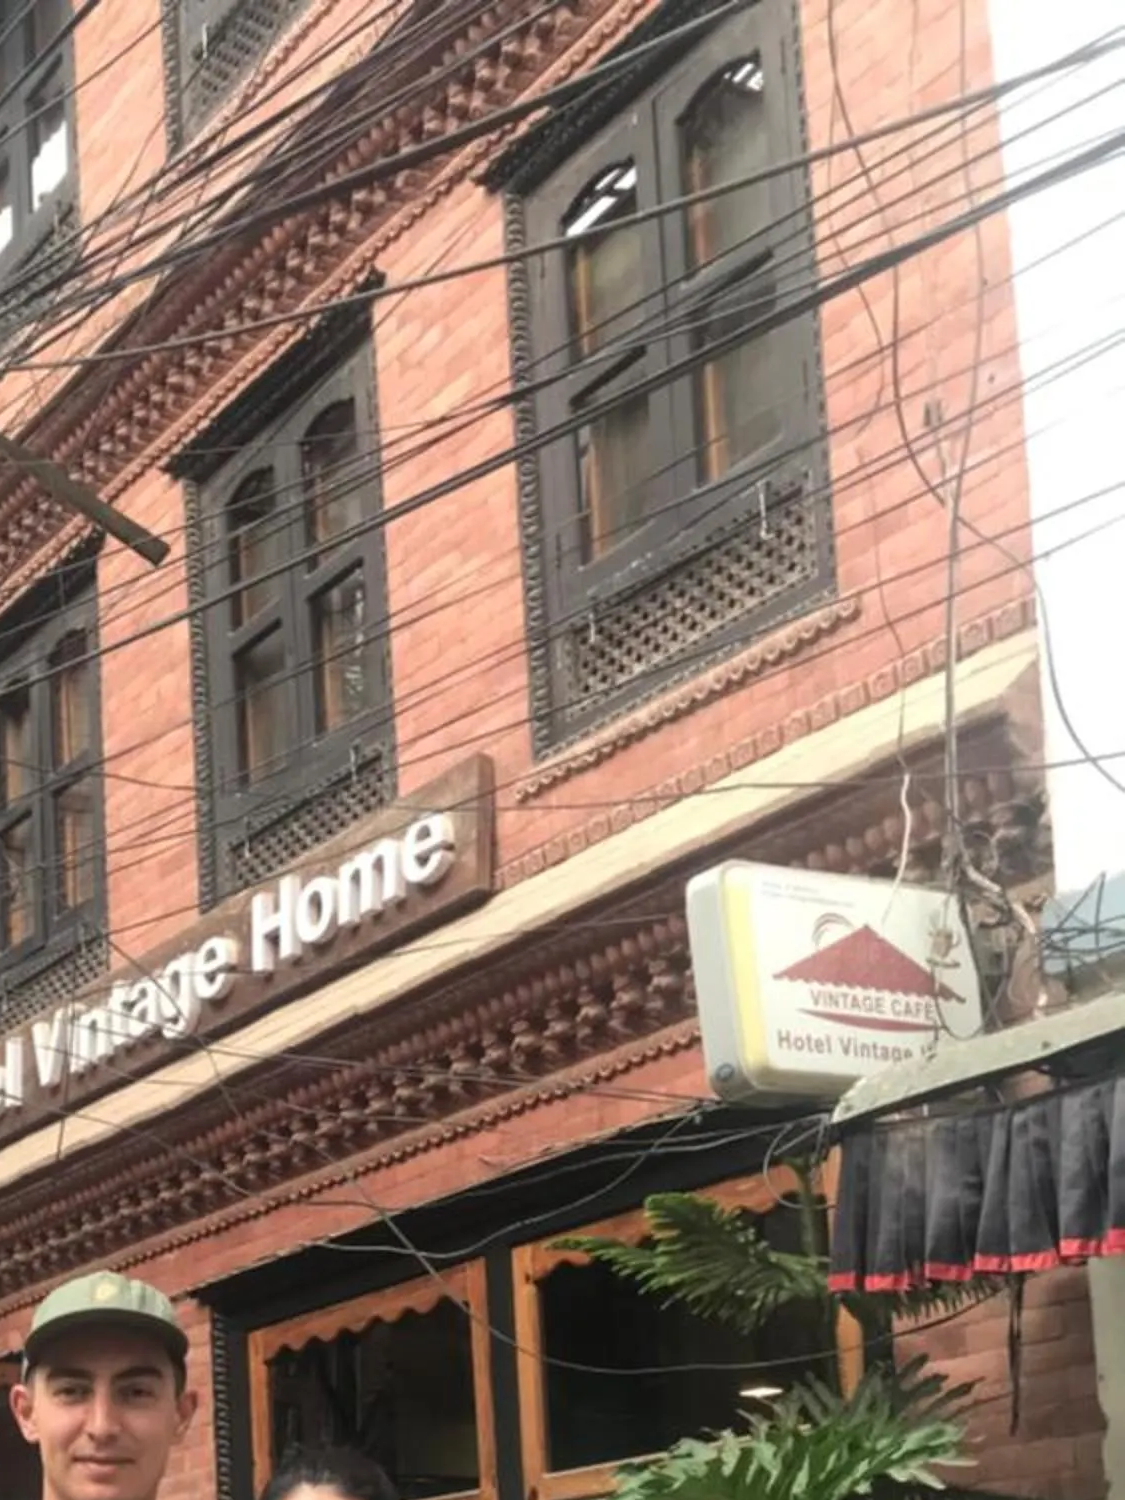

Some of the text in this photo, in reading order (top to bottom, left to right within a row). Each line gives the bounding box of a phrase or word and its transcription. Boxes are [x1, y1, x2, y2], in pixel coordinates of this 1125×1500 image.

[31, 935, 239, 1087] Vintage
[251, 811, 455, 972] Home
[810, 989, 886, 1014] VINTAGE
[777, 1029, 832, 1054] Hotel
[839, 1037, 913, 1063] Vintage
